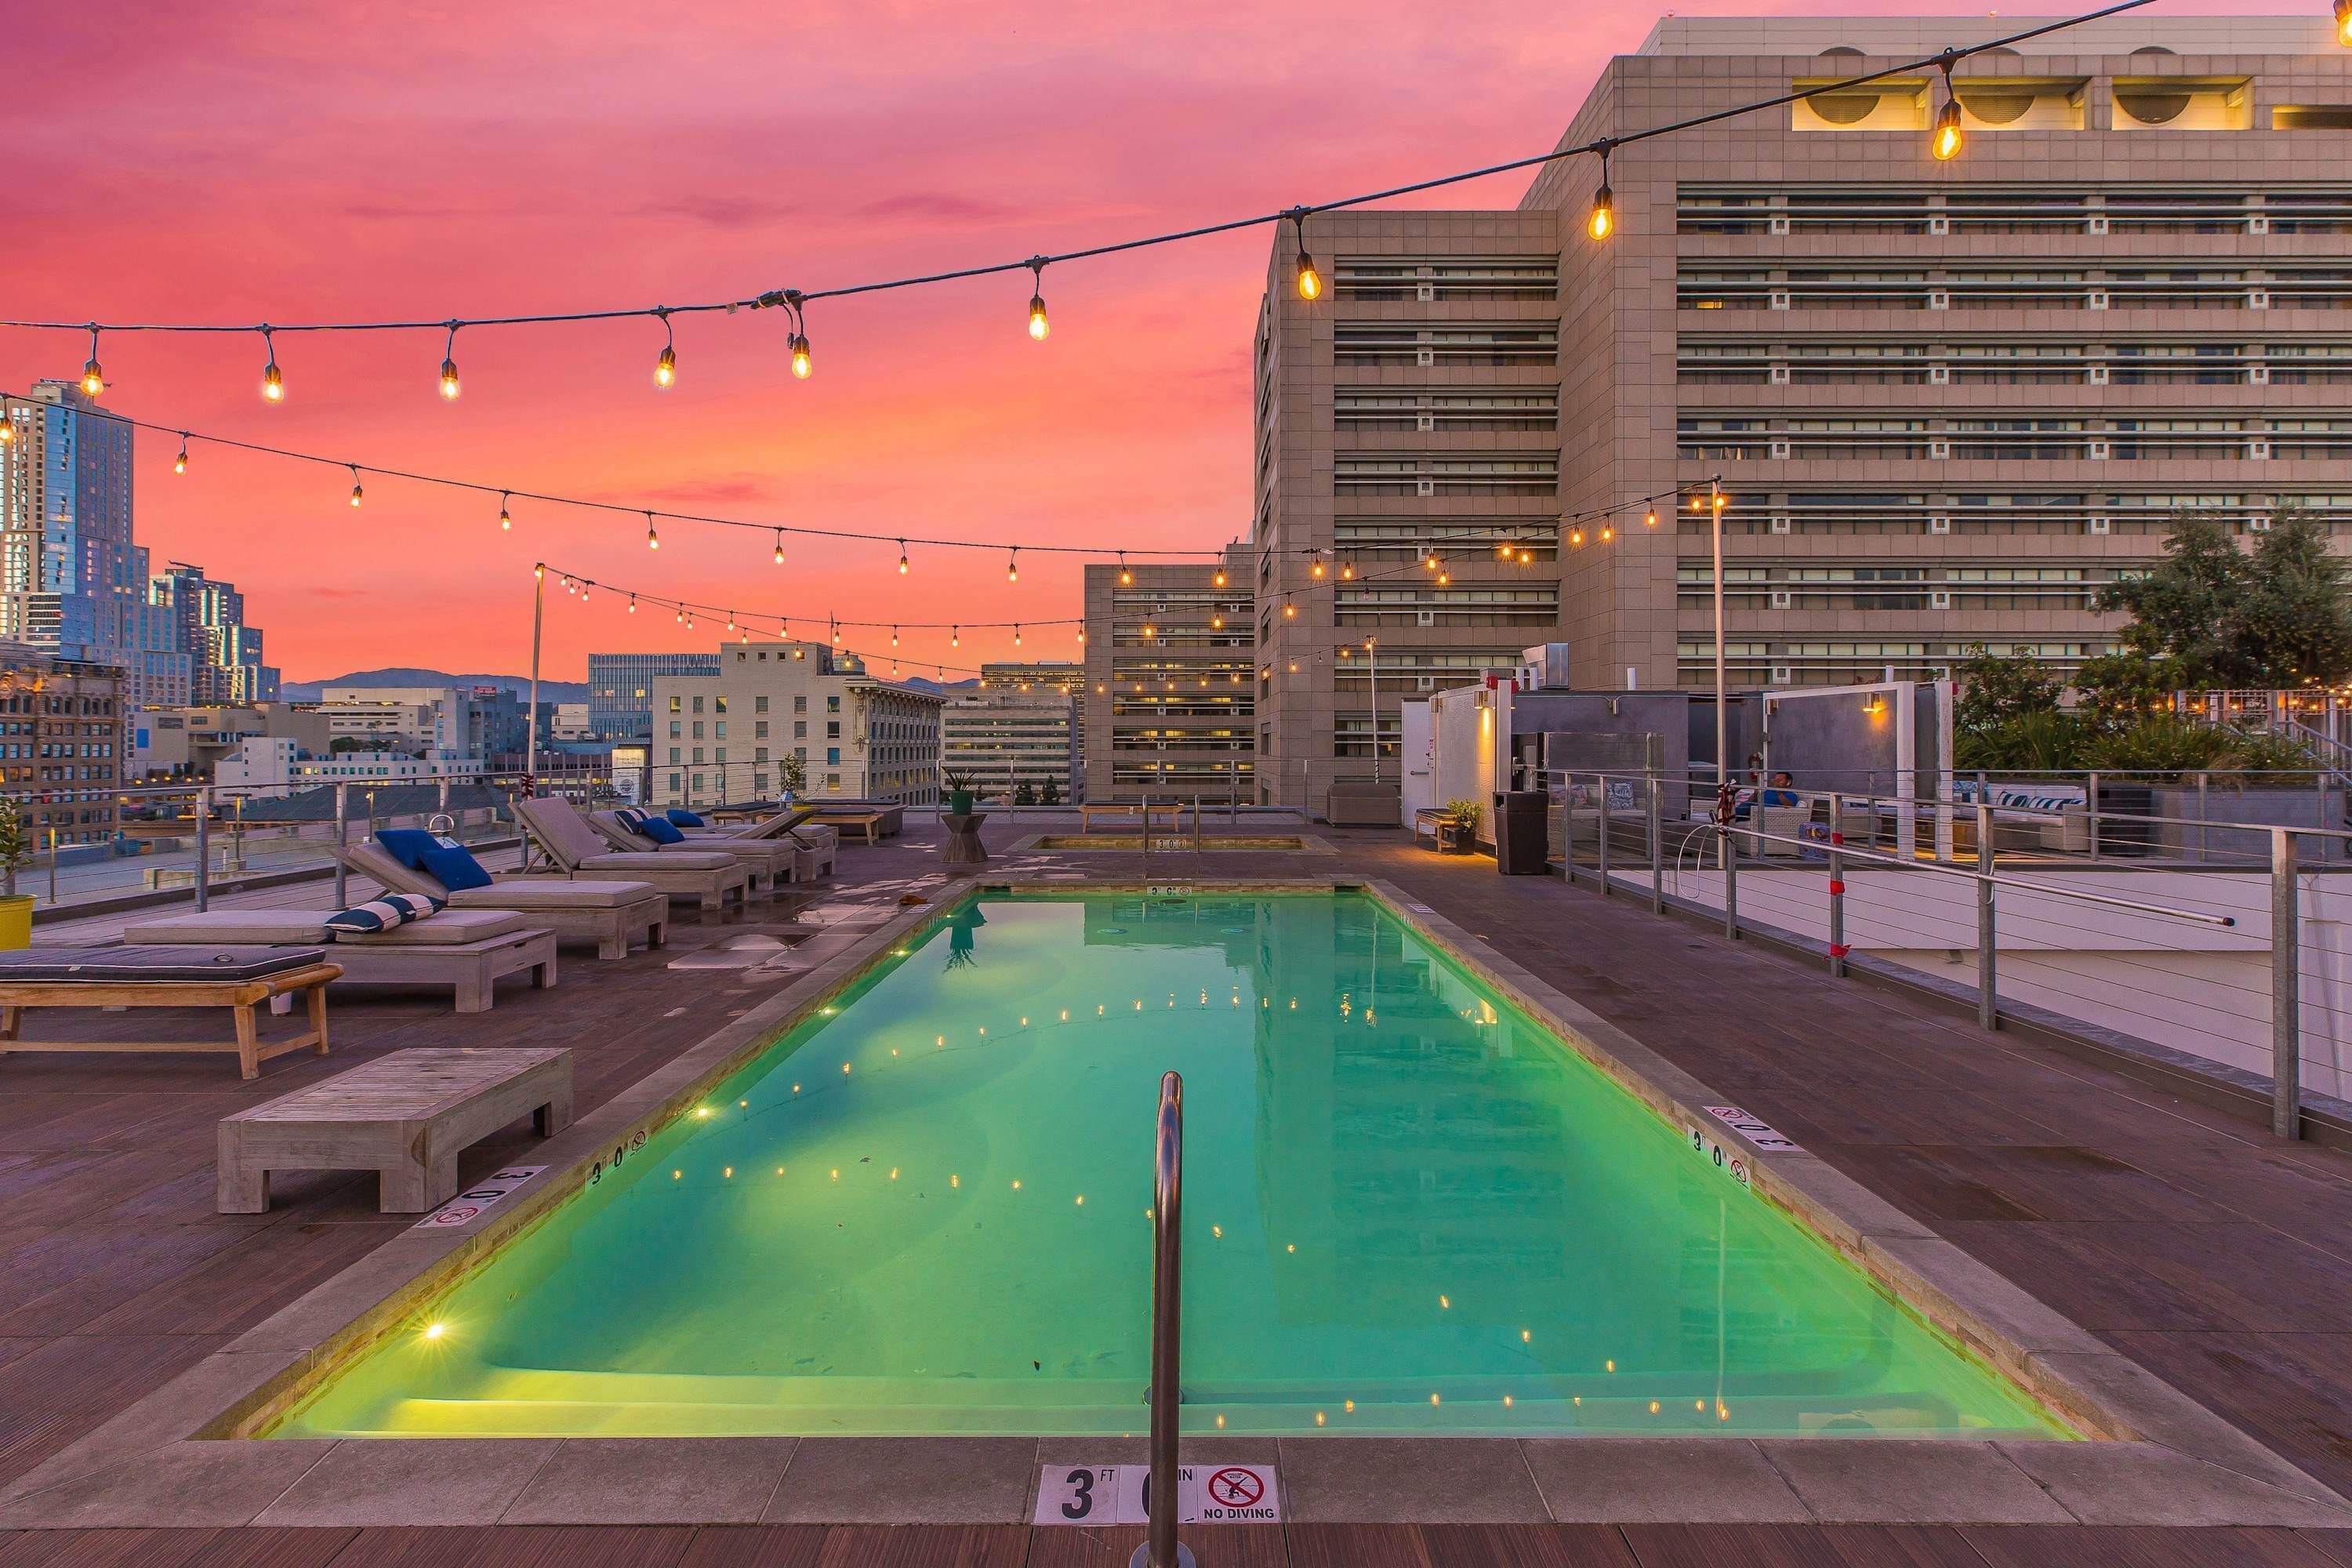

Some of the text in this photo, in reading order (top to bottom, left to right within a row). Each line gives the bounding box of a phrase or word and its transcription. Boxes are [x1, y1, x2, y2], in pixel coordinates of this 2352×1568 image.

[1693, 1131, 1700, 1151] 3
[1713, 1145, 1722, 1167] 0
[491, 1171, 535, 1180] 3
[592, 1162, 601, 1185] 3
[614, 1146, 622, 1167] 0
[461, 1190, 506, 1200] 0
[1062, 1468, 1192, 1519] 3 FT IN
[1203, 1508, 1275, 1519] NO DIVING
